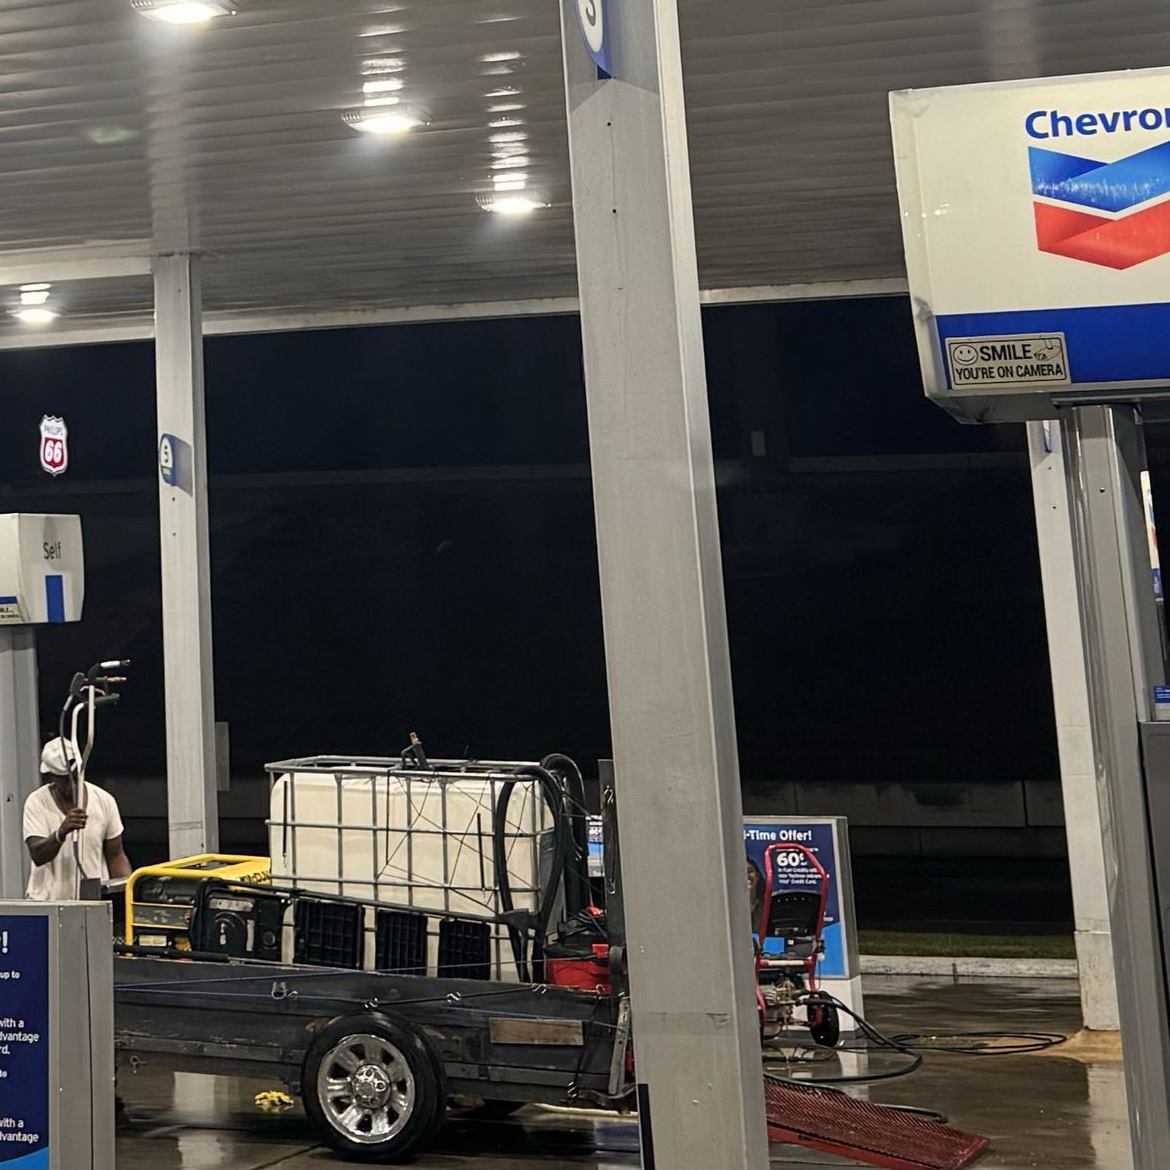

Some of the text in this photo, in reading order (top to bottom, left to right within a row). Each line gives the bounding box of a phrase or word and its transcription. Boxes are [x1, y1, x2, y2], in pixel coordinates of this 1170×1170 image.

[980, 343, 1032, 361] SMILE
[955, 363, 1063, 380] YOU'RE ON CAMERA
[45, 439, 63, 463] 66
[43, 541, 61, 560] Self
[779, 829, 812, 841] Offer!
[0, 971, 10, 980] up
[11, 970, 20, 979] to
[18, 1019, 25, 1028] a
[17, 1119, 24, 1128] a
